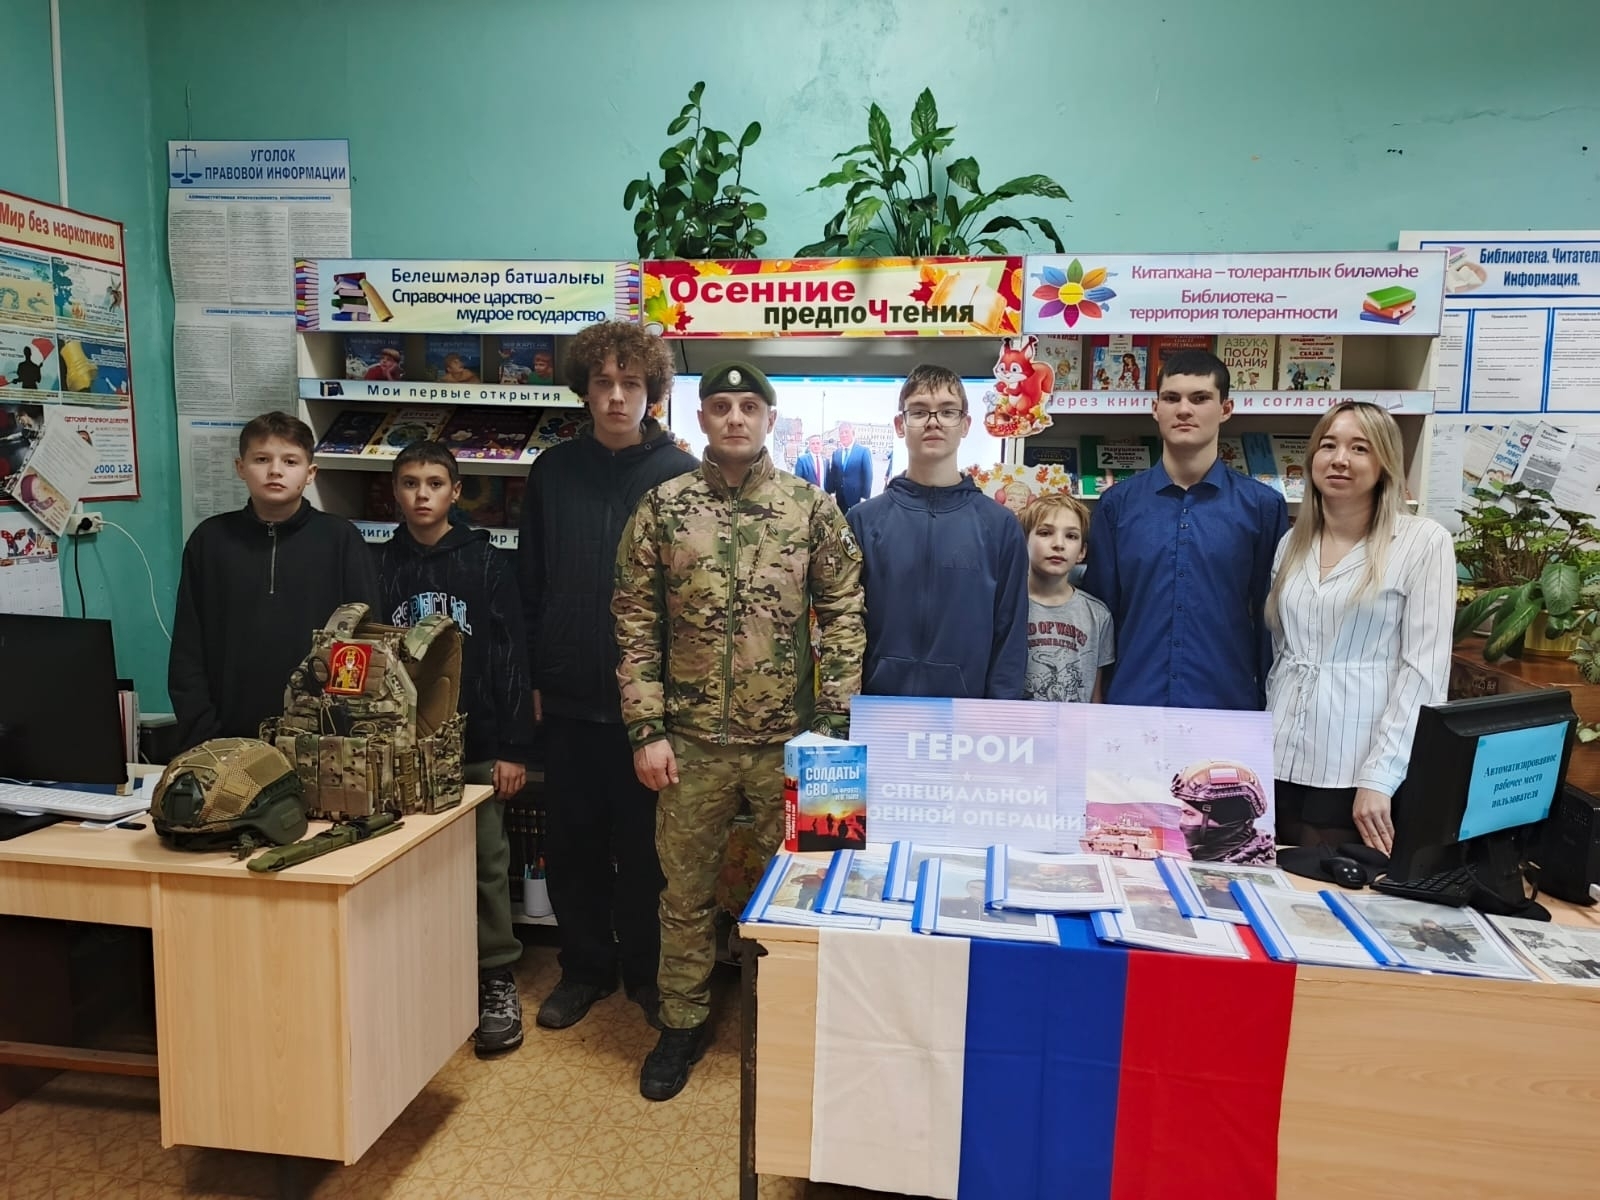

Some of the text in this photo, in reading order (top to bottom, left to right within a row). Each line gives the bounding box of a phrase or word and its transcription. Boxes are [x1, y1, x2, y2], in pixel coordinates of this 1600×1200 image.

[250, 149, 295, 162] УГОЛОК
[205, 164, 346, 181] ПРАВОВОЙ ИНФОРМАЦИИ
[0, 202, 115, 250] Мир без наркотиков
[1480, 248, 1549, 265] Библиотека.
[391, 268, 604, 287] Белешмәләр батшалығы
[1131, 265, 1212, 280] Китапхана
[1227, 265, 1331, 281] толерантлык
[1334, 263, 1418, 278] биләмәһе
[1503, 271, 1581, 288] Информация.
[391, 288, 480, 306] Справочное
[483, 290, 543, 306] царство
[669, 274, 856, 304] Осенние
[1181, 289, 1273, 304] Библиотека
[456, 308, 606, 324] мудрое государство
[763, 300, 974, 330] предпоЧтения
[1129, 307, 1338, 323] территория толерантности
[1225, 338, 1268, 348] АЗБУКА
[1224, 347, 1268, 358] ПОСЛУ
[1223, 358, 1267, 369] ШАНИЯ
[367, 384, 561, 402] Мои первые открытия
[1107, 397, 1156, 407] книг
[1244, 397, 1253, 407] и
[1101, 452, 1114, 465] 2
[118, 464, 133, 473] 122
[907, 731, 1034, 765] ГЕРОИ
[805, 766, 860, 782] СОЛДАТЫ
[1483, 753, 1557, 779] Автоматизированное
[805, 783, 828, 796] СВО
[1493, 772, 1543, 795] рабочее место
[881, 783, 1048, 805] СПЕЦИАЛЬНОЙ
[1491, 789, 1539, 808] пользователя
[867, 804, 1082, 831] ОЕННОЙ ОПЕРАЦИИ
